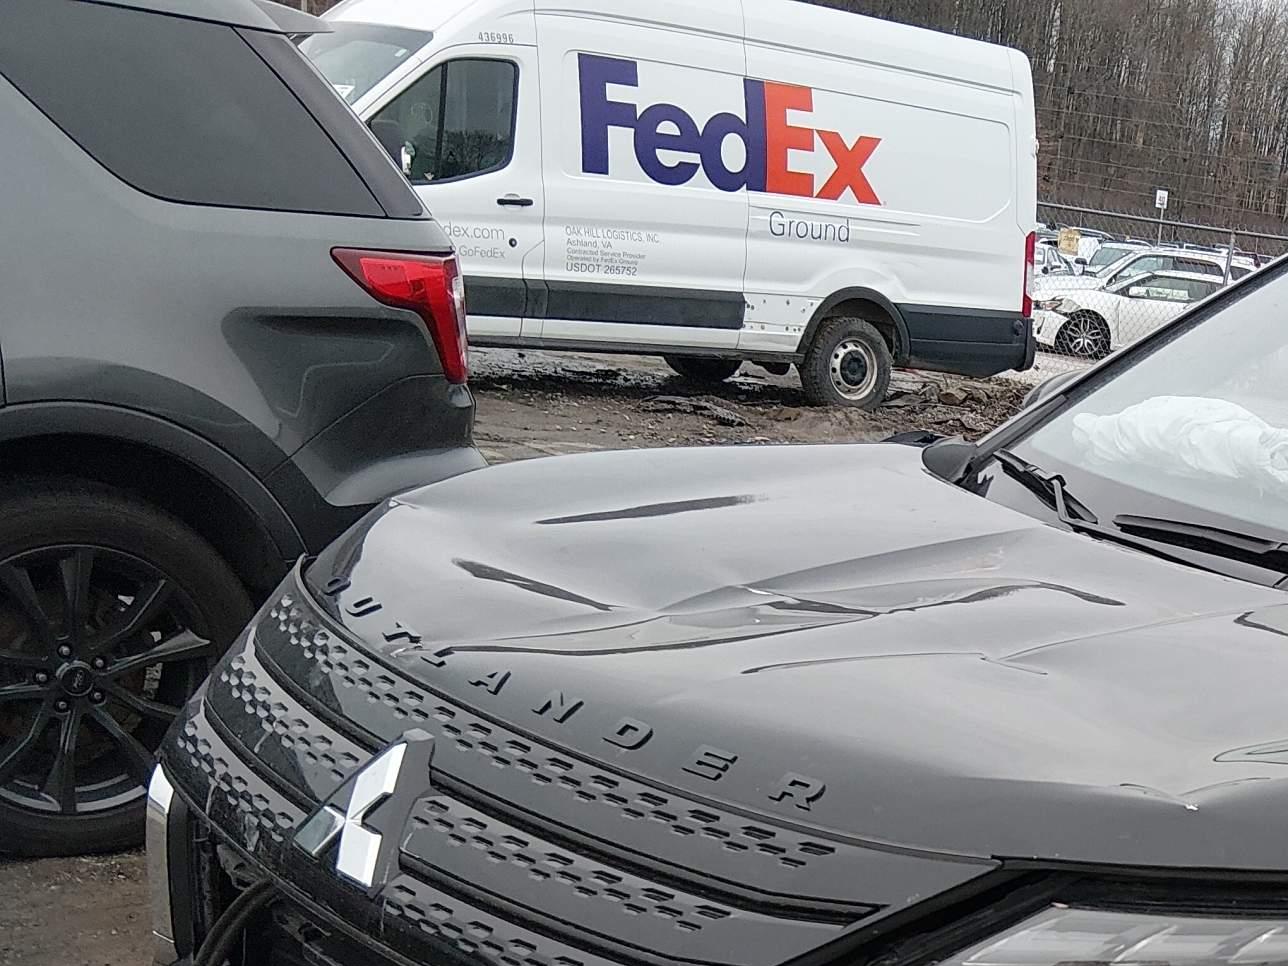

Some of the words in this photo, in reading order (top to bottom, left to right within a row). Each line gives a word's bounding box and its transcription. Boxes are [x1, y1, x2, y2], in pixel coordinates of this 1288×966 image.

[577, 52, 882, 206] FedEx
[398, 177, 409, 193] D
[565, 225, 583, 237] OAK
[583, 226, 601, 239] HILL
[769, 210, 851, 243] Ground
[601, 240, 613, 249] VA
[566, 262, 601, 273] USDOT
[603, 264, 638, 277] 265752
